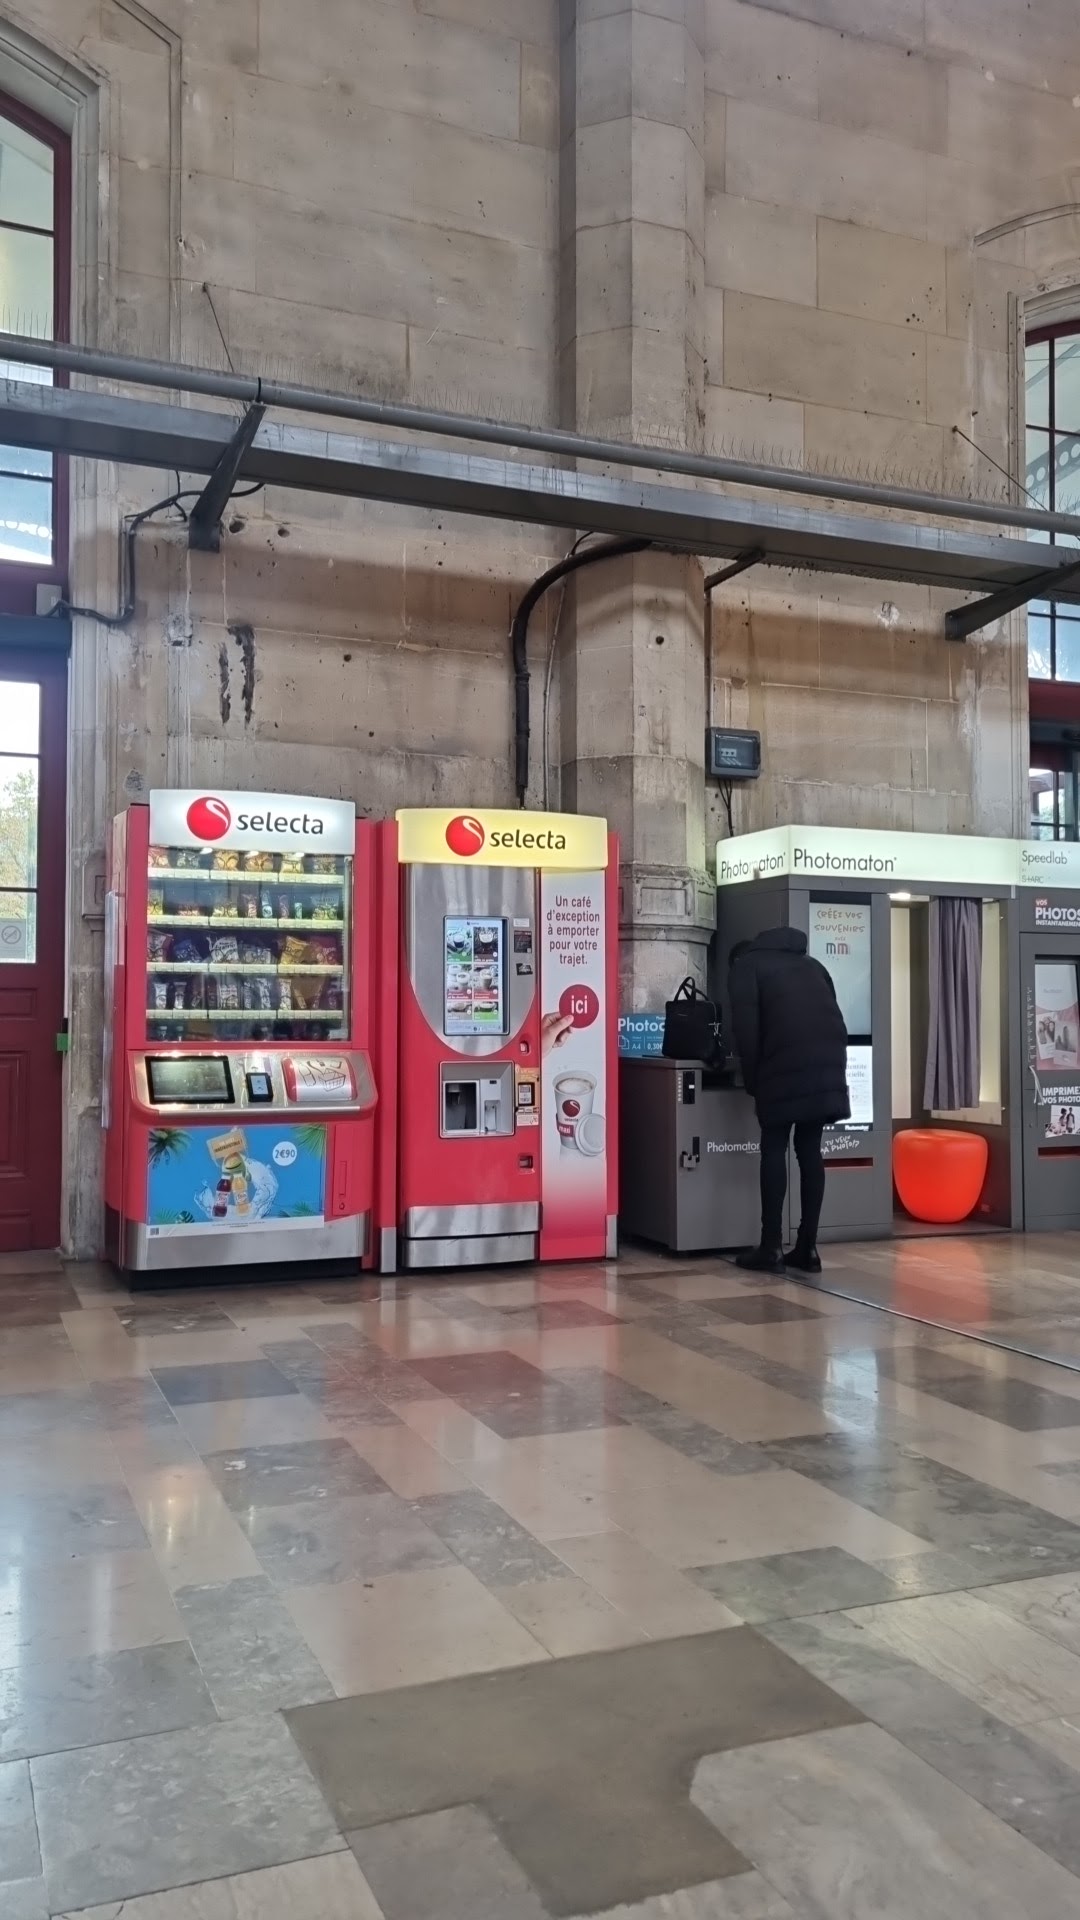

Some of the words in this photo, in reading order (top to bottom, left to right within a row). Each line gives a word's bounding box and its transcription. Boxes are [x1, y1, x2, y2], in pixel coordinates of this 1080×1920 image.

[236, 811, 324, 835] selecta
[489, 829, 566, 850] selecta
[793, 848, 895, 873] Photomaton
[1021, 850, 1068, 866] Speedlab
[720, 853, 785, 880] Photoaton
[555, 895, 569, 907] Un
[571, 896, 592, 908] café
[1035, 898, 1048, 906] VOS
[546, 909, 600, 924] d'exception
[547, 923, 553, 936] à
[556, 925, 599, 938] emporter
[814, 924, 866, 934] SOUVENIRS
[549, 940, 571, 952] pour
[574, 939, 598, 951] votre
[559, 953, 588, 967] trajet.
[571, 995, 588, 1014] ici
[1042, 1086, 1080, 1096] IMPRIME
[274, 1149, 296, 1159] 2€90
